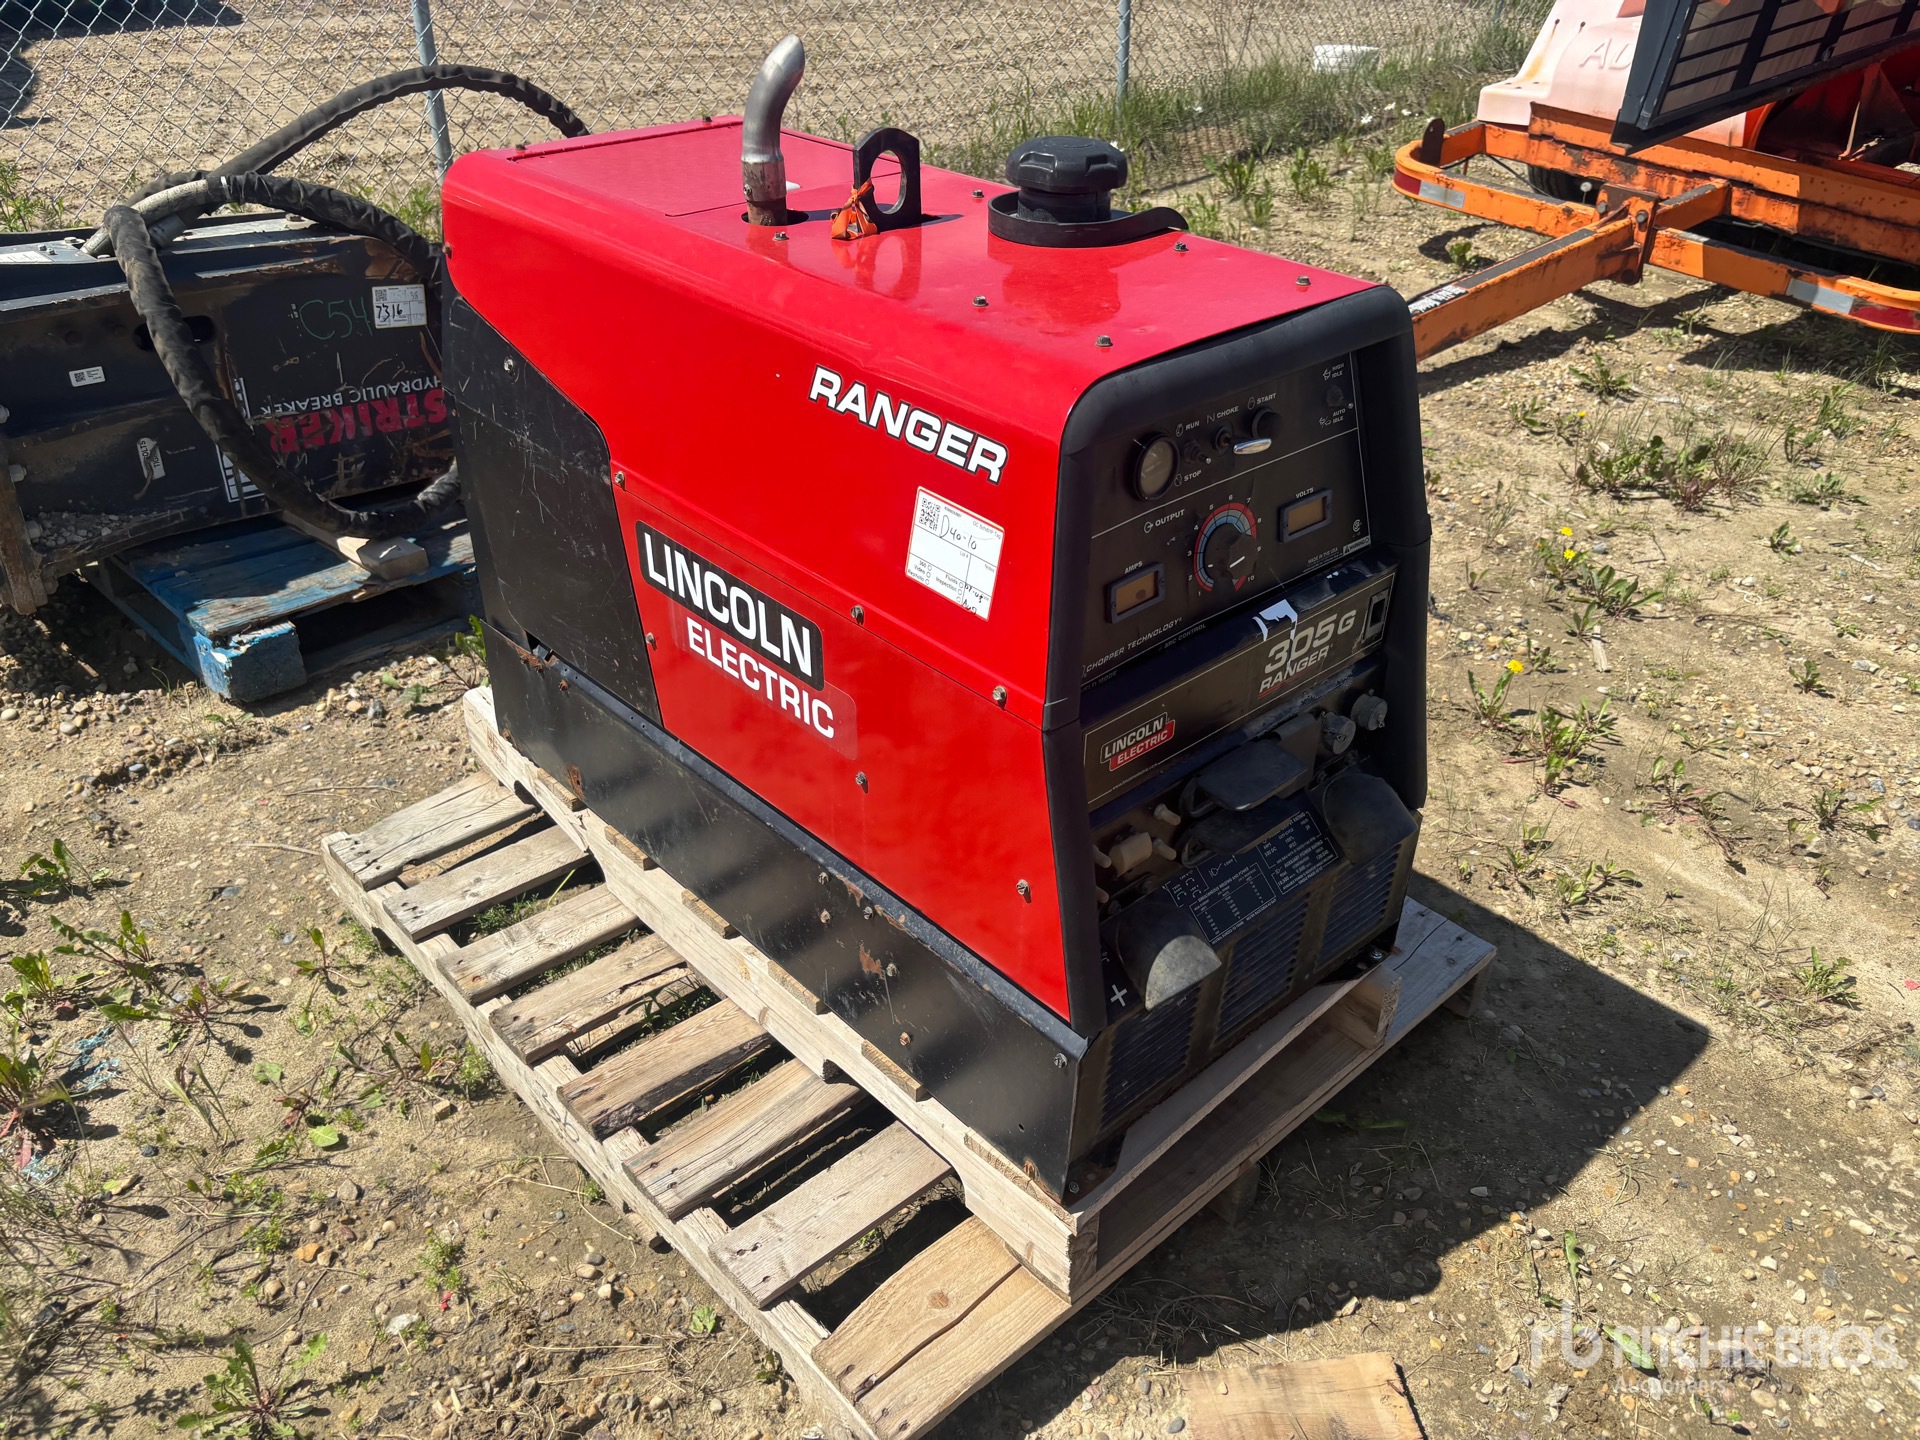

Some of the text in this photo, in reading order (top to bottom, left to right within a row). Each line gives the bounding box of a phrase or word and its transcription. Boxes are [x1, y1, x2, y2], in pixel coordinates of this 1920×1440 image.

[299, 296, 373, 340] C54
[375, 303, 403, 322] 7316
[349, 375, 442, 402] HYDRAULIC
[1256, 392, 1277, 405] START
[264, 388, 447, 453] STRIKER
[808, 364, 1008, 485] RANGER
[1216, 405, 1239, 419] CHOKE
[1333, 408, 1346, 417] AUTO
[1185, 420, 1200, 431] RUN
[1183, 470, 1202, 482] STOP
[1295, 487, 1314, 499] VOLTS
[1155, 508, 1185, 527] OUTPUT
[940, 514, 977, 550] D40-10
[1124, 560, 1143, 574] AMPS
[644, 532, 812, 677] LINCOLN
[1164, 623, 1206, 649] ARC CONTROL
[1086, 647, 1125, 673] CHOPPER
[1259, 645, 1330, 693] RANGER
[686, 616, 834, 739] ELECTRIC
[1104, 717, 1164, 759] LINCOLN
[1117, 730, 1168, 765] ELECTRIC
